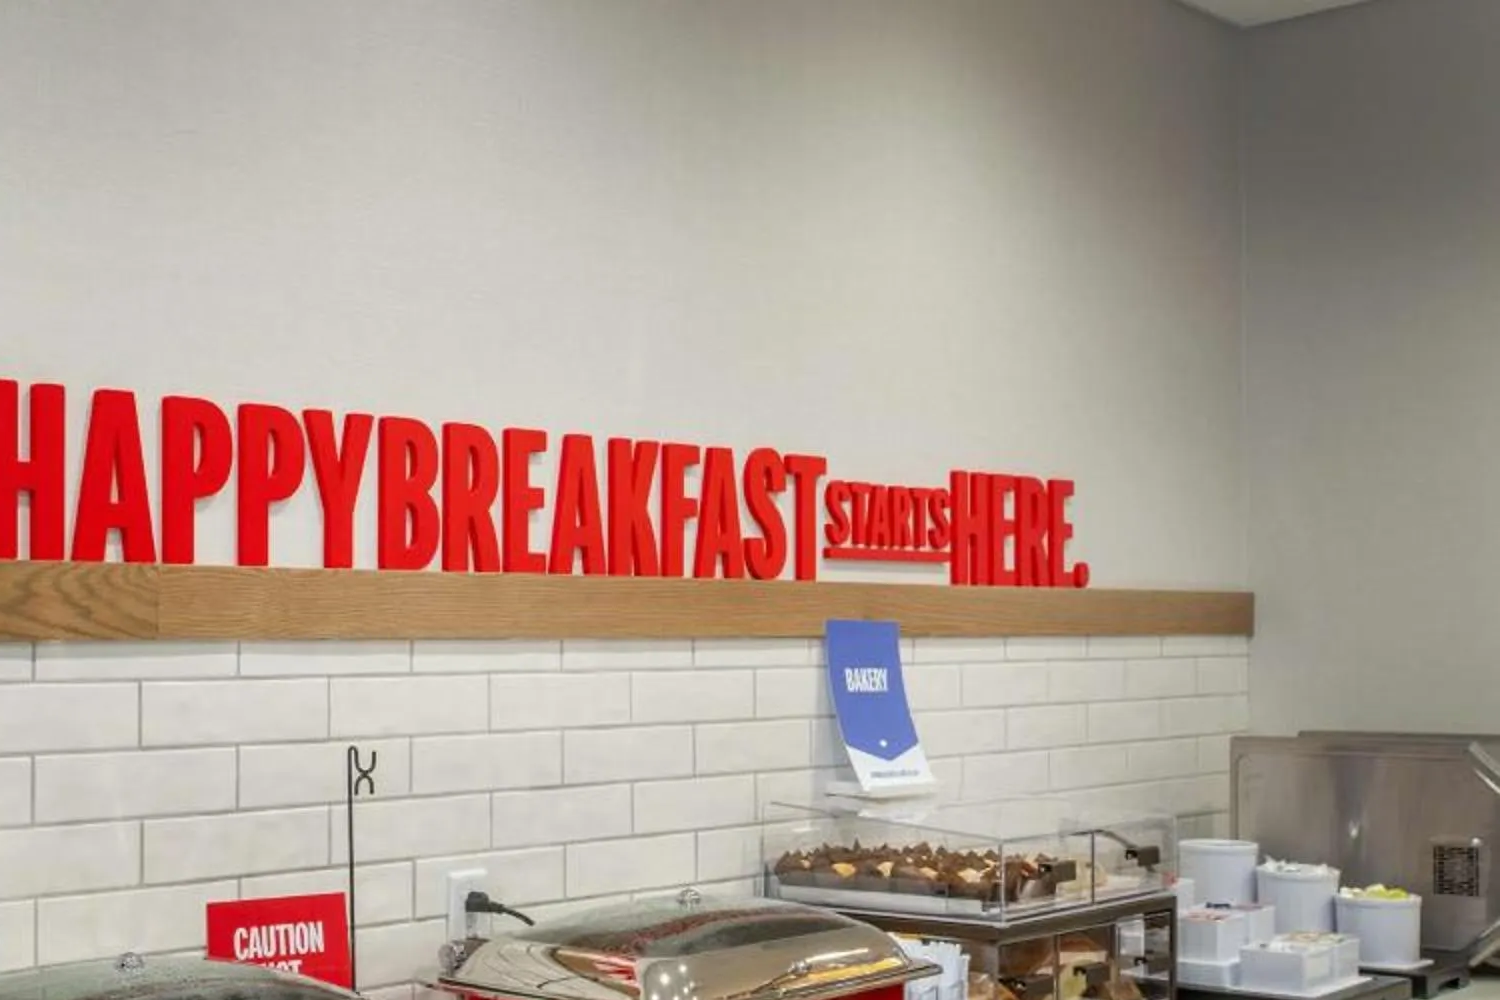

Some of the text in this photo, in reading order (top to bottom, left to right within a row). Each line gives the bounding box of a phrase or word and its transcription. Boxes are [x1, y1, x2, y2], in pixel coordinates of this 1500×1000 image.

[377, 415, 828, 582] BREAKFAST
[823, 479, 951, 550] STARTS
[949, 470, 1090, 588] HERE.
[844, 667, 889, 693] BAKERY
[233, 920, 325, 961] CAUTION
